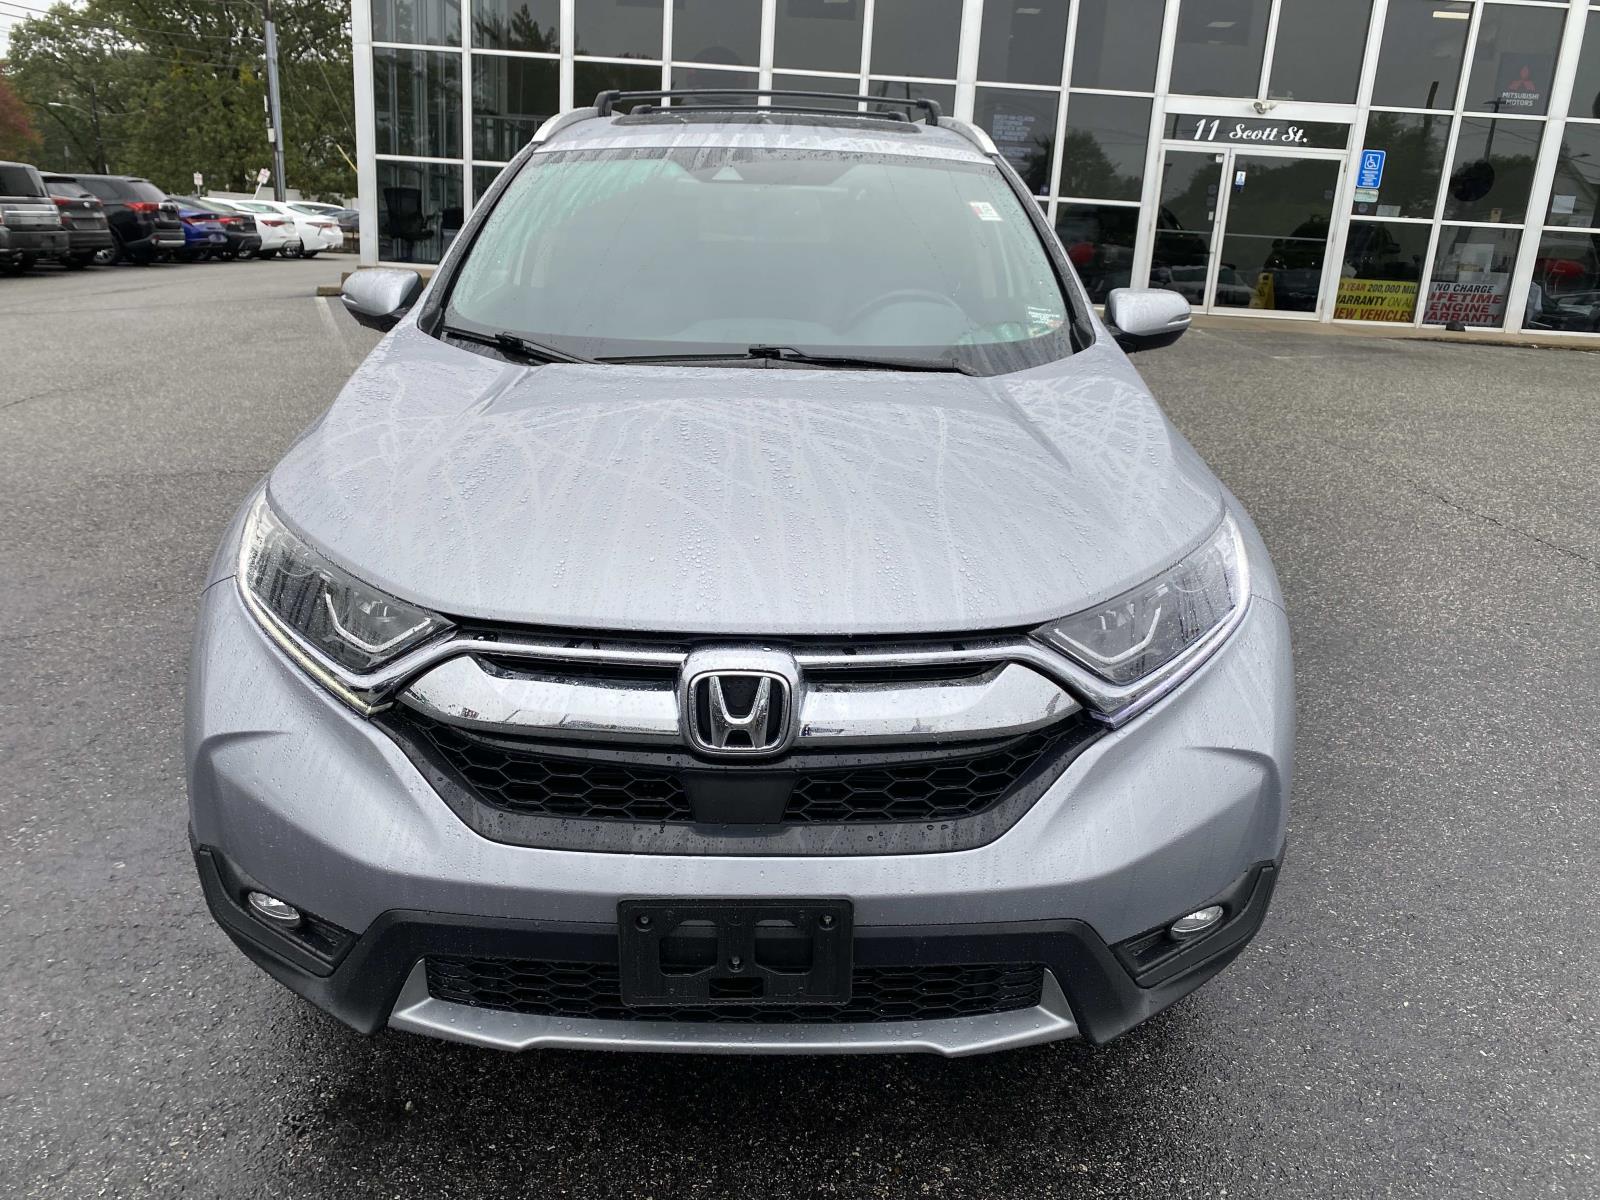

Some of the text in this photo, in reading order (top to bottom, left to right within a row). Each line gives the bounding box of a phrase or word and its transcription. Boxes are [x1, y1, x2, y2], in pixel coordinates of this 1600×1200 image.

[1502, 91, 1540, 99] MITSUBISHI
[1194, 118, 1308, 143] 11 Scott St.
[1367, 283, 1400, 294] 200,000
[1402, 285, 1417, 294] MIL
[1435, 283, 1494, 293] NO CHARGE
[1430, 292, 1503, 304] IFETIME
[1430, 302, 1490, 313] ENGINE
[1360, 308, 1413, 322] VEHICLES
